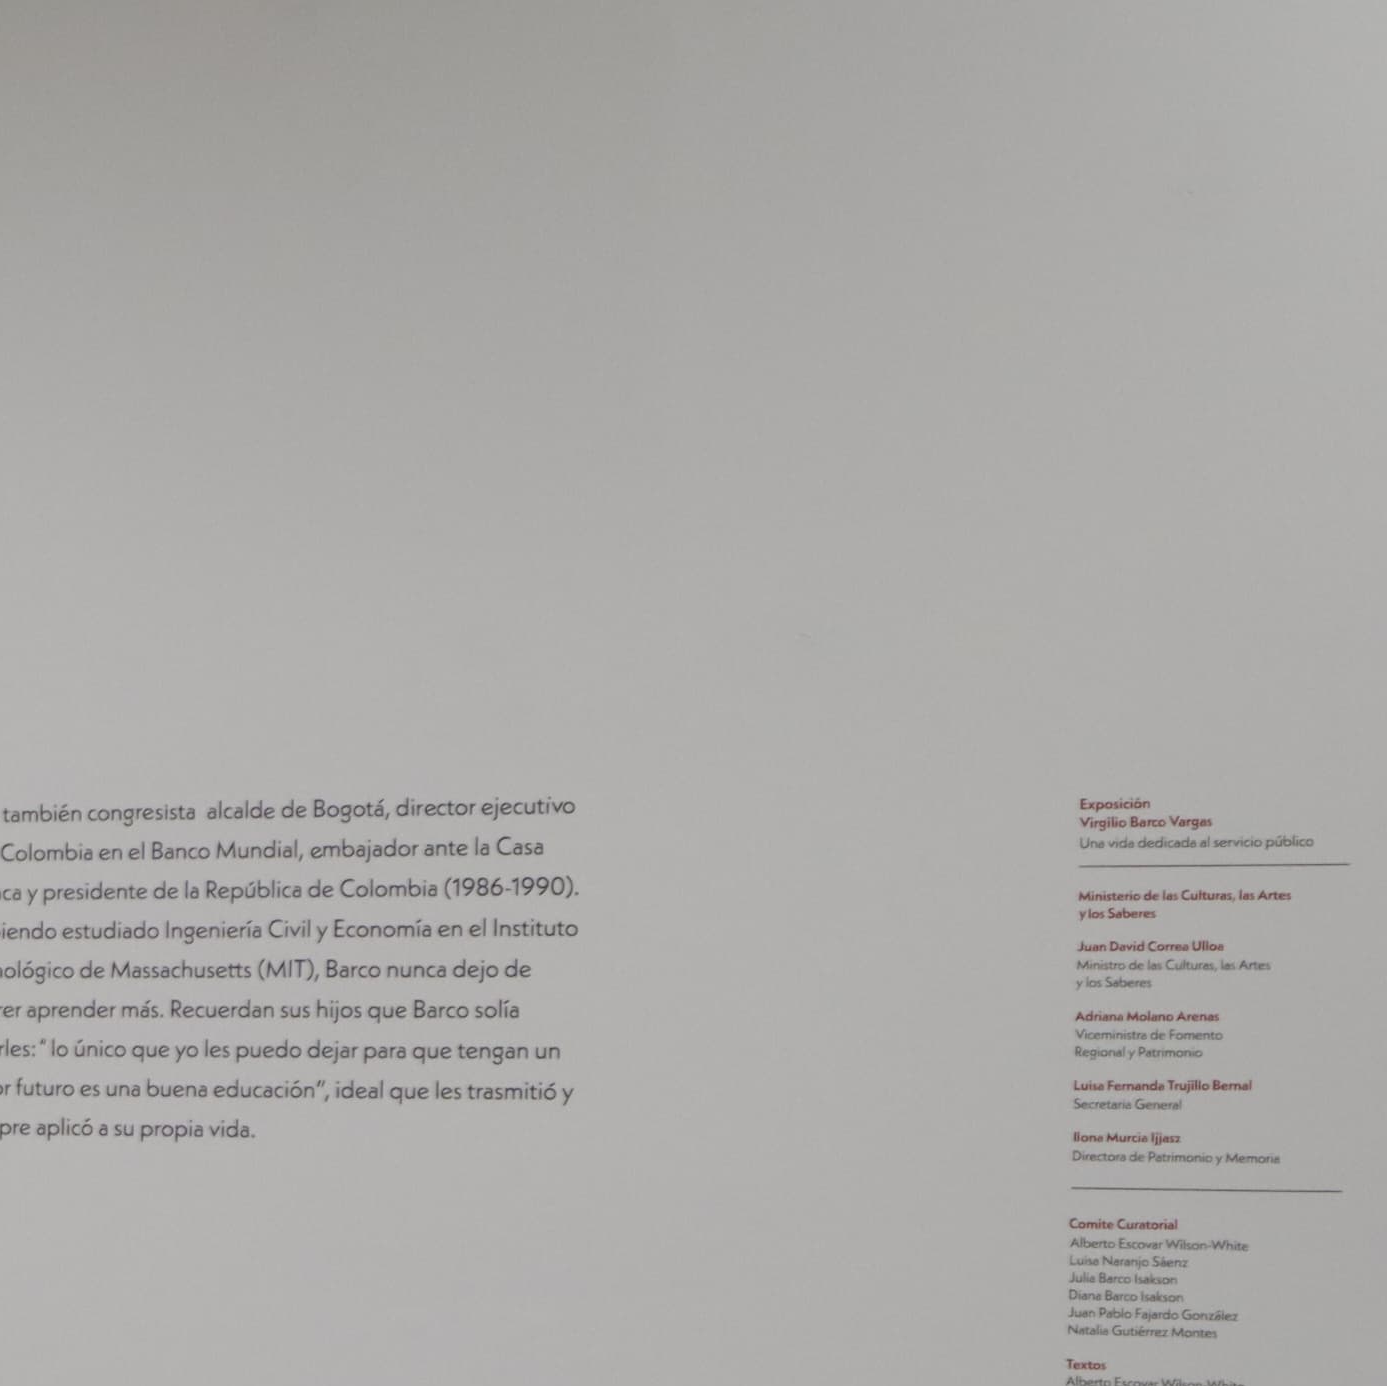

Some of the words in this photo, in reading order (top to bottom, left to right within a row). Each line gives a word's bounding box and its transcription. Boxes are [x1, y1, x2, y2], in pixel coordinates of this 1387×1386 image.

[2, 803, 82, 823] también
[86, 804, 196, 827] congresista
[206, 799, 275, 820] alcalde
[280, 798, 307, 819] de
[312, 798, 390, 824] Bogotá,
[395, 796, 476, 817] director
[480, 796, 576, 821] ejecutivo
[1079, 797, 1150, 813] Exposición
[1079, 816, 1127, 832] Virgilio
[1130, 815, 1167, 828] Barco
[1168, 815, 1212, 830] Vargas
[1079, 837, 1105, 849] Una
[1108, 837, 1135, 849] vida
[1137, 836, 1197, 849] dedicada
[1199, 835, 1210, 848] al
[1212, 837, 1263, 848] servicio
[1264, 834, 1314, 850] público
[27, 888, 38, 906] y
[42, 881, 148, 906] presidente
[152, 880, 179, 900] de
[184, 879, 200, 900] la
[205, 879, 302, 904] República
[306, 879, 334, 898] de
[339, 877, 438, 898] Colombia
[443, 875, 579, 900] (1986-1990).
[1078, 890, 1141, 901] Ministerio
[1143, 889, 1160, 901] de
[1162, 890, 1179, 901] las
[1238, 889, 1255, 900] las
[1257, 890, 1291, 901] Artes
[1077, 941, 1107, 952] Juan
[1109, 940, 1145, 952] David
[1147, 940, 1189, 952] Correa
[1191, 940, 1224, 952] Ulloa
[79, 959, 105, 979] de
[110, 959, 252, 979] Massachusetts
[257, 957, 320, 982] (MIT),
[325, 958, 381, 979] Barco
[386, 964, 447, 978] nunca
[451, 958, 499, 984] dejo
[503, 958, 532, 978] de
[1073, 1079, 1105, 1091] Luisa
[1106, 1079, 1165, 1091] Fernanda
[1167, 1079, 1210, 1094] Trujillo
[1211, 1079, 1252, 1091] Bernal
[1116, 1218, 1178, 1230] Curatorial
